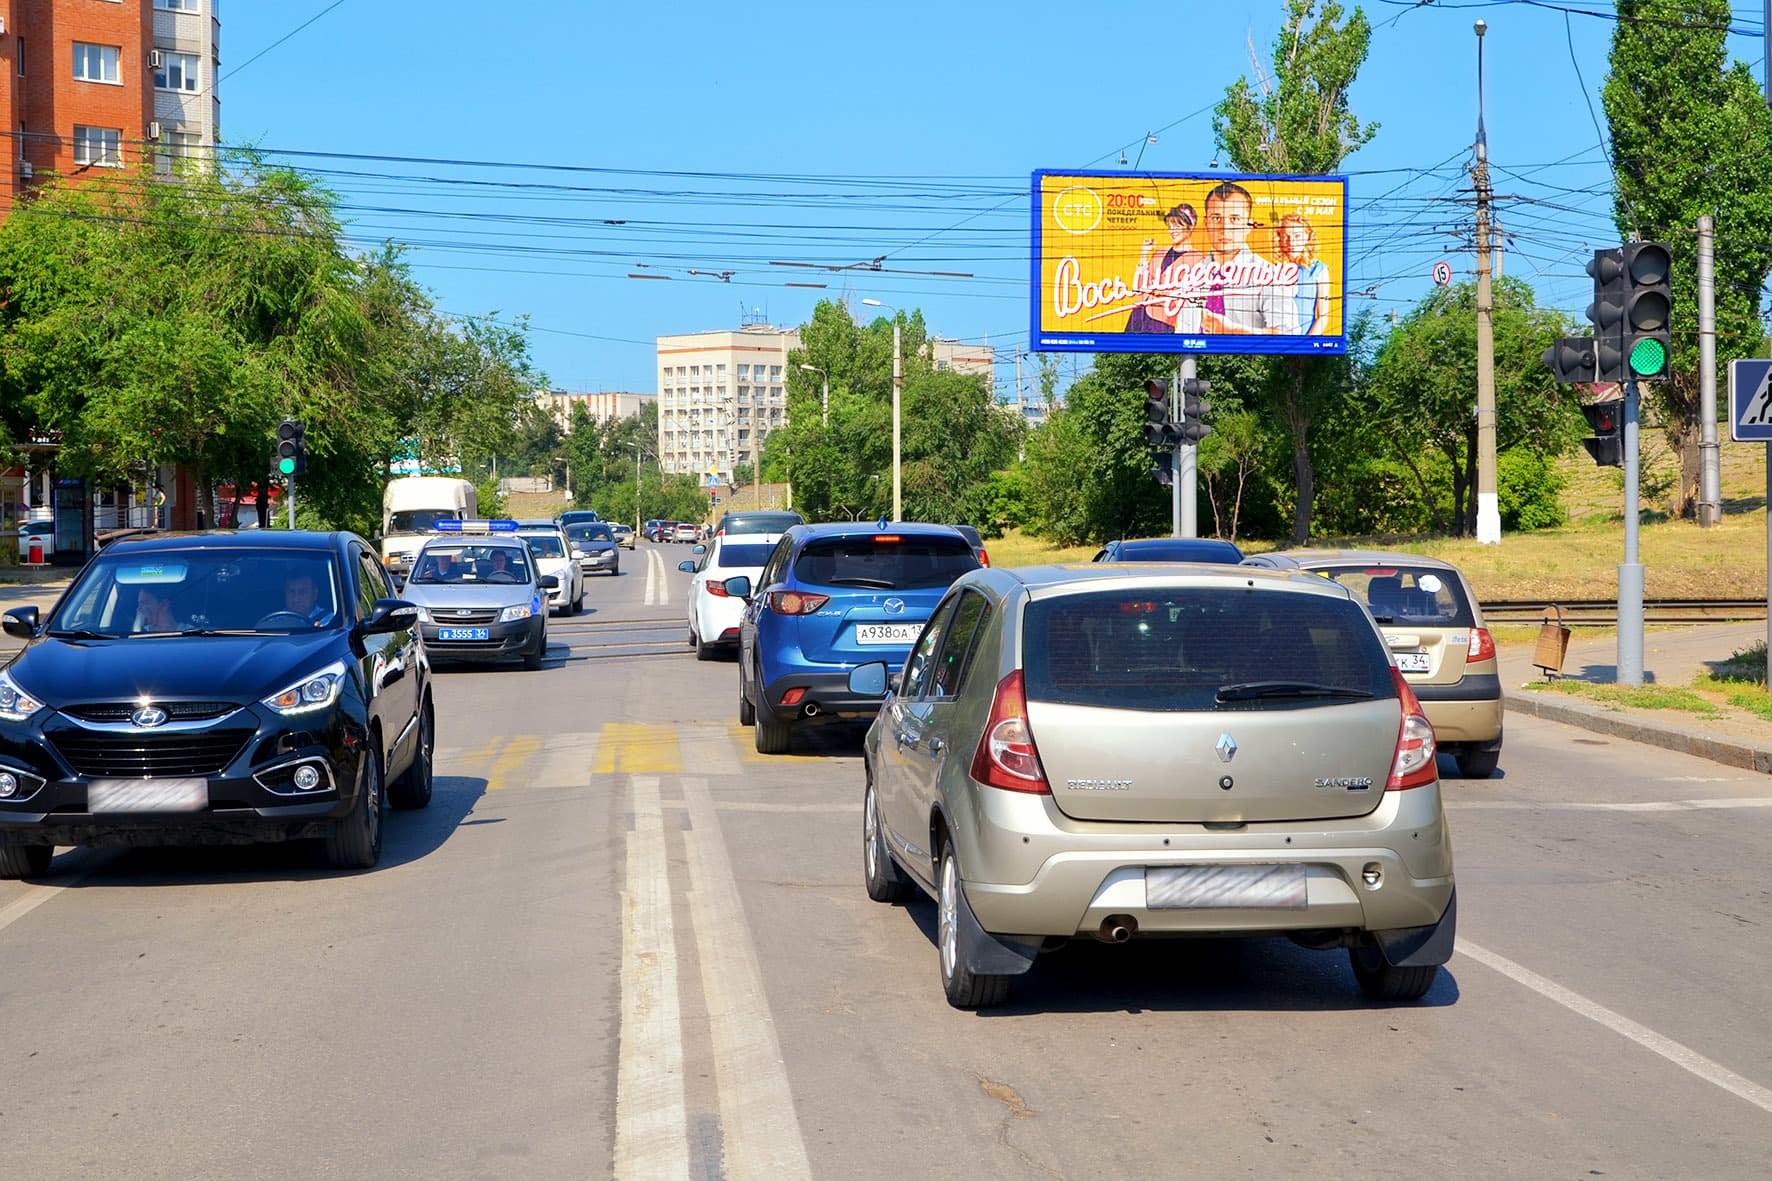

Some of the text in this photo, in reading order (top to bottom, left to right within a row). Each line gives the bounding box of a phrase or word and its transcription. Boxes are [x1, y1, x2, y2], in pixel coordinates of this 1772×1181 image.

[1062, 204, 1093, 217] СТС
[1106, 217, 1138, 225] ЧЕТВЕРГ
[1436, 265, 1447, 282] 15
[1053, 256, 1299, 318] Восьмидесятые
[451, 629, 473, 639] 3555
[1067, 779, 1134, 790] RENAULT
[1314, 777, 1374, 788] SANDERO
